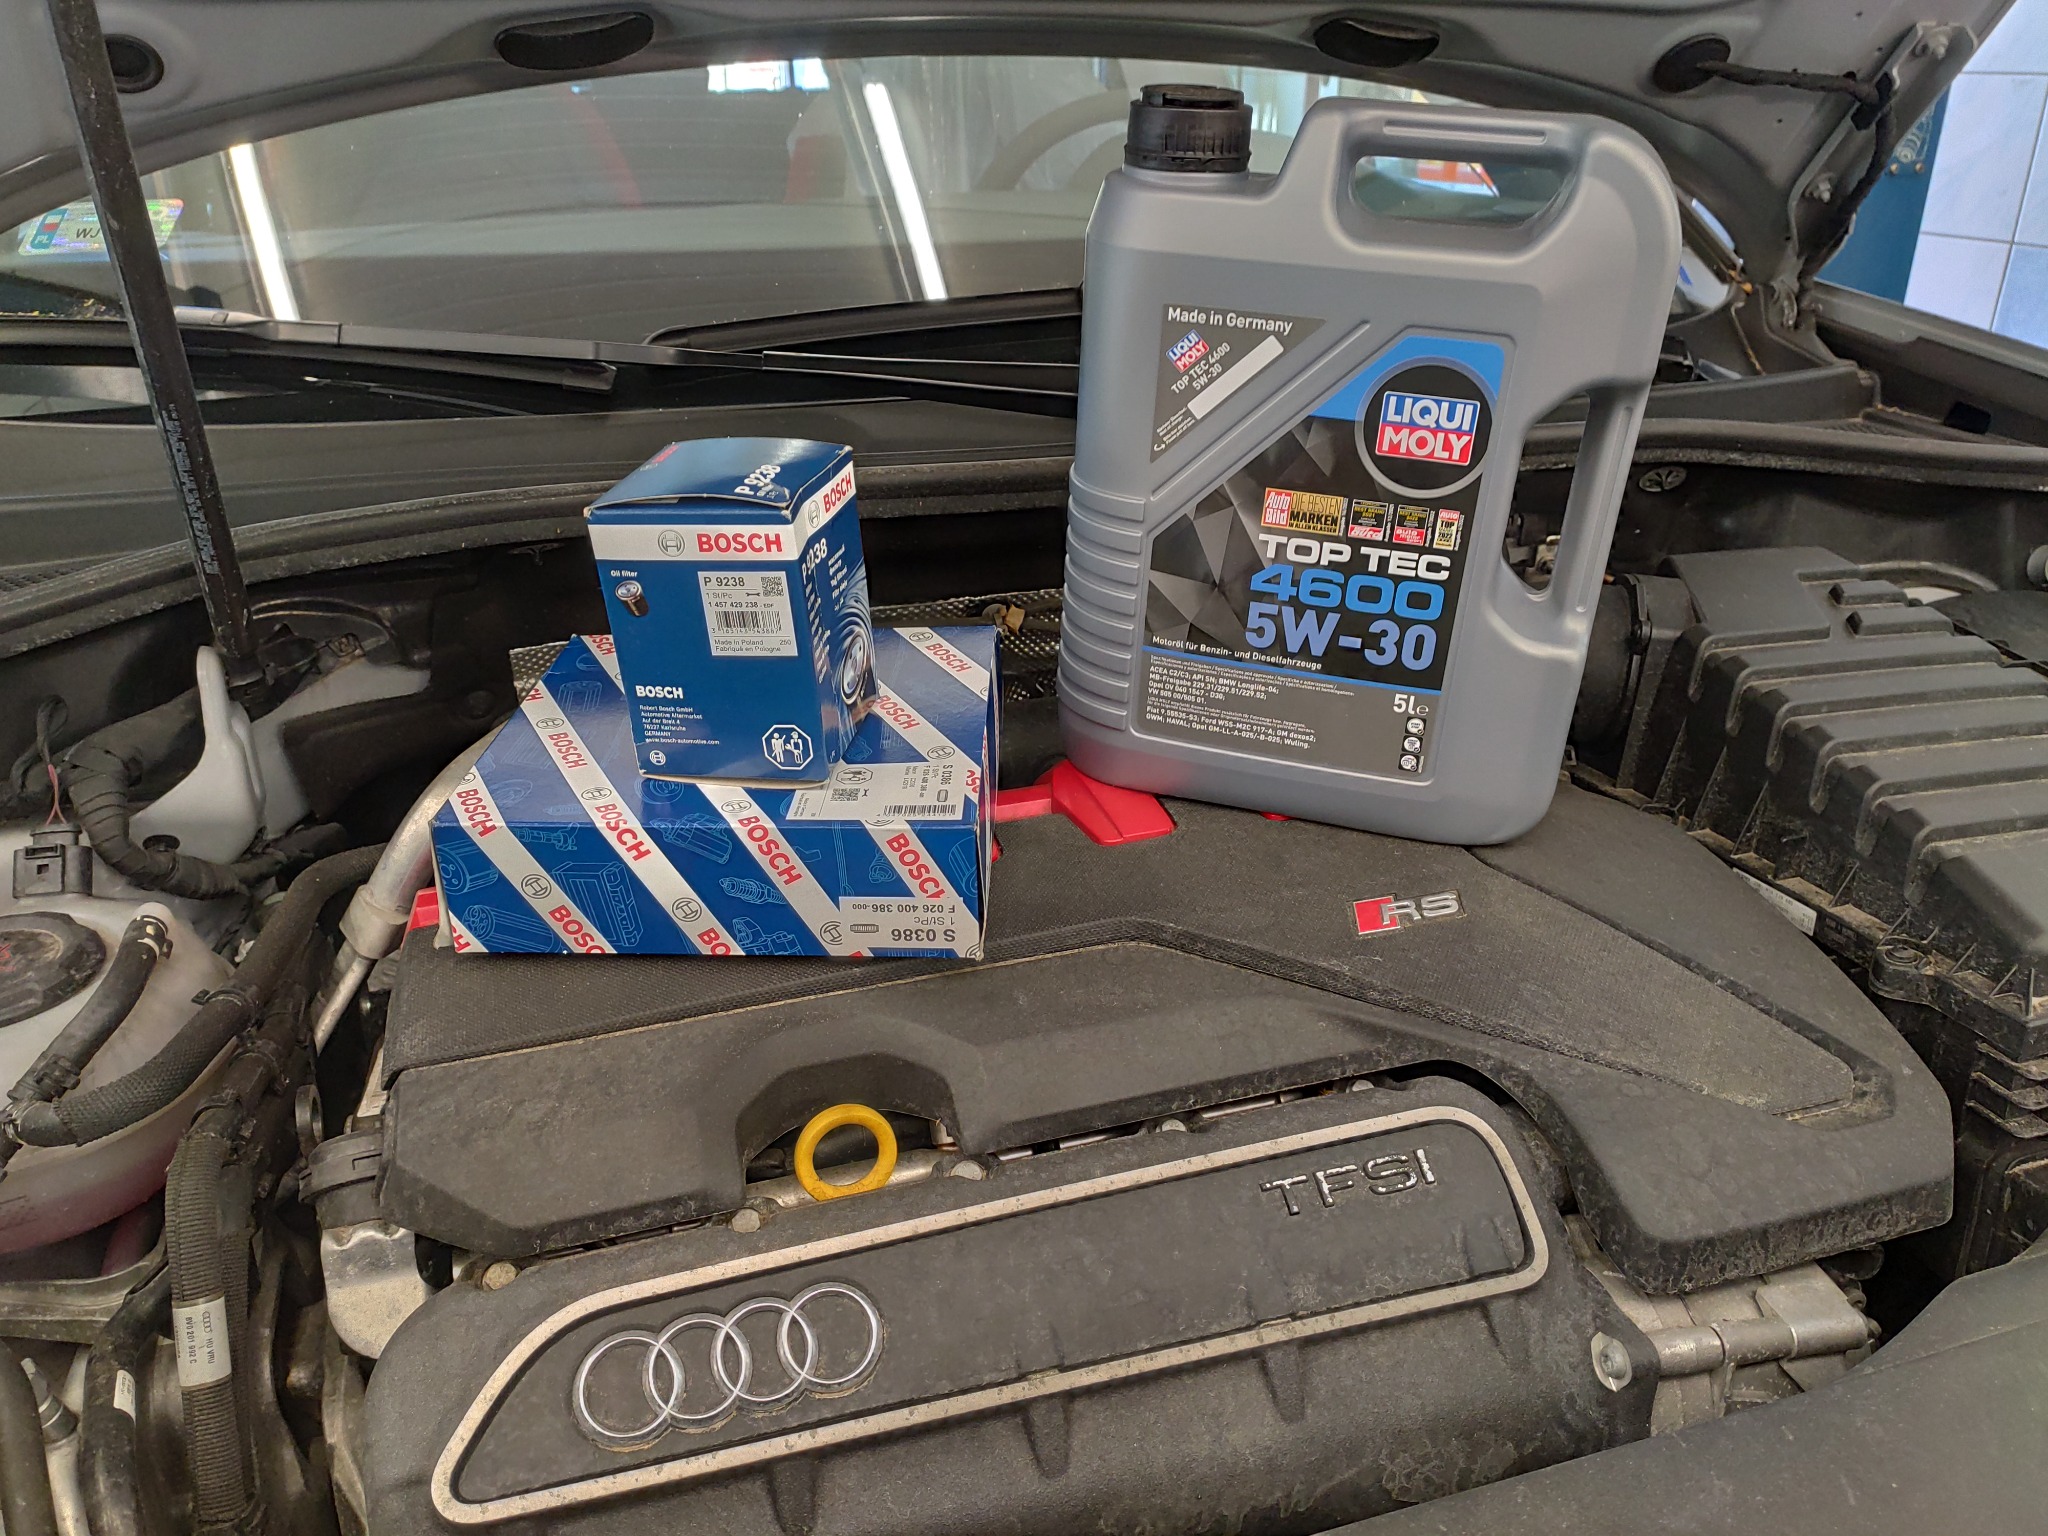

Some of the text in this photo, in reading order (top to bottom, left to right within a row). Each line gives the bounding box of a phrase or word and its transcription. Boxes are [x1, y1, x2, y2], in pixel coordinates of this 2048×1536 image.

[1167, 307, 1293, 336] Made in Germany
[1168, 333, 1200, 361] LIQUI
[1176, 341, 1206, 371] MOLY
[1170, 342, 1230, 394] TOP TEC 4600
[1192, 363, 1222, 390] 5W-30
[1386, 396, 1472, 431] LIQUI
[1382, 427, 1471, 460] MOLY
[743, 464, 782, 488] 9238
[734, 485, 755, 497] P
[823, 472, 852, 513] BOSCH
[1266, 492, 1291, 510] Auto
[1292, 493, 1341, 515] DIE BESTEN
[1265, 508, 1288, 525] Bild
[1290, 510, 1339, 527] MARKEN
[696, 532, 783, 553] BOSCH
[801, 562, 808, 585] P
[806, 538, 827, 575] 9238
[1258, 534, 1451, 581] TOP TEC
[703, 576, 745, 587] P 9238
[1250, 564, 1445, 621] 4600
[1245, 603, 1437, 671] 5W-30
[925, 643, 972, 672] BOSCH
[1152, 635, 1322, 671] Motoröl für Benzin- und Dieselfahrzeuge
[1148, 680, 1164, 690] Opel
[1164, 683, 1175, 691] OV
[1150, 666, 1168, 676] ACEA
[1192, 672, 1204, 681] API
[1218, 677, 1237, 688] BMW
[635, 685, 684, 699] BOSCH
[1148, 687, 1159, 695] VW
[876, 695, 920, 730] BOSCH
[1146, 705, 1159, 713] Fiat
[1201, 716, 1216, 724] Ford
[1191, 721, 1207, 731] Opel
[547, 732, 588, 769] BOSCH
[456, 788, 497, 838] BOSCH
[595, 803, 652, 862] BOSCH
[737, 815, 803, 886] BOSCH
[897, 904, 919, 913] 400
[914, 916, 955, 925] 1 St/Pc
[923, 904, 944, 913] 026
[948, 905, 955, 913] F
[1380, 891, 1459, 925] RS
[890, 928, 956, 942] S 0386
[1259, 1149, 1436, 1216] TFSI
